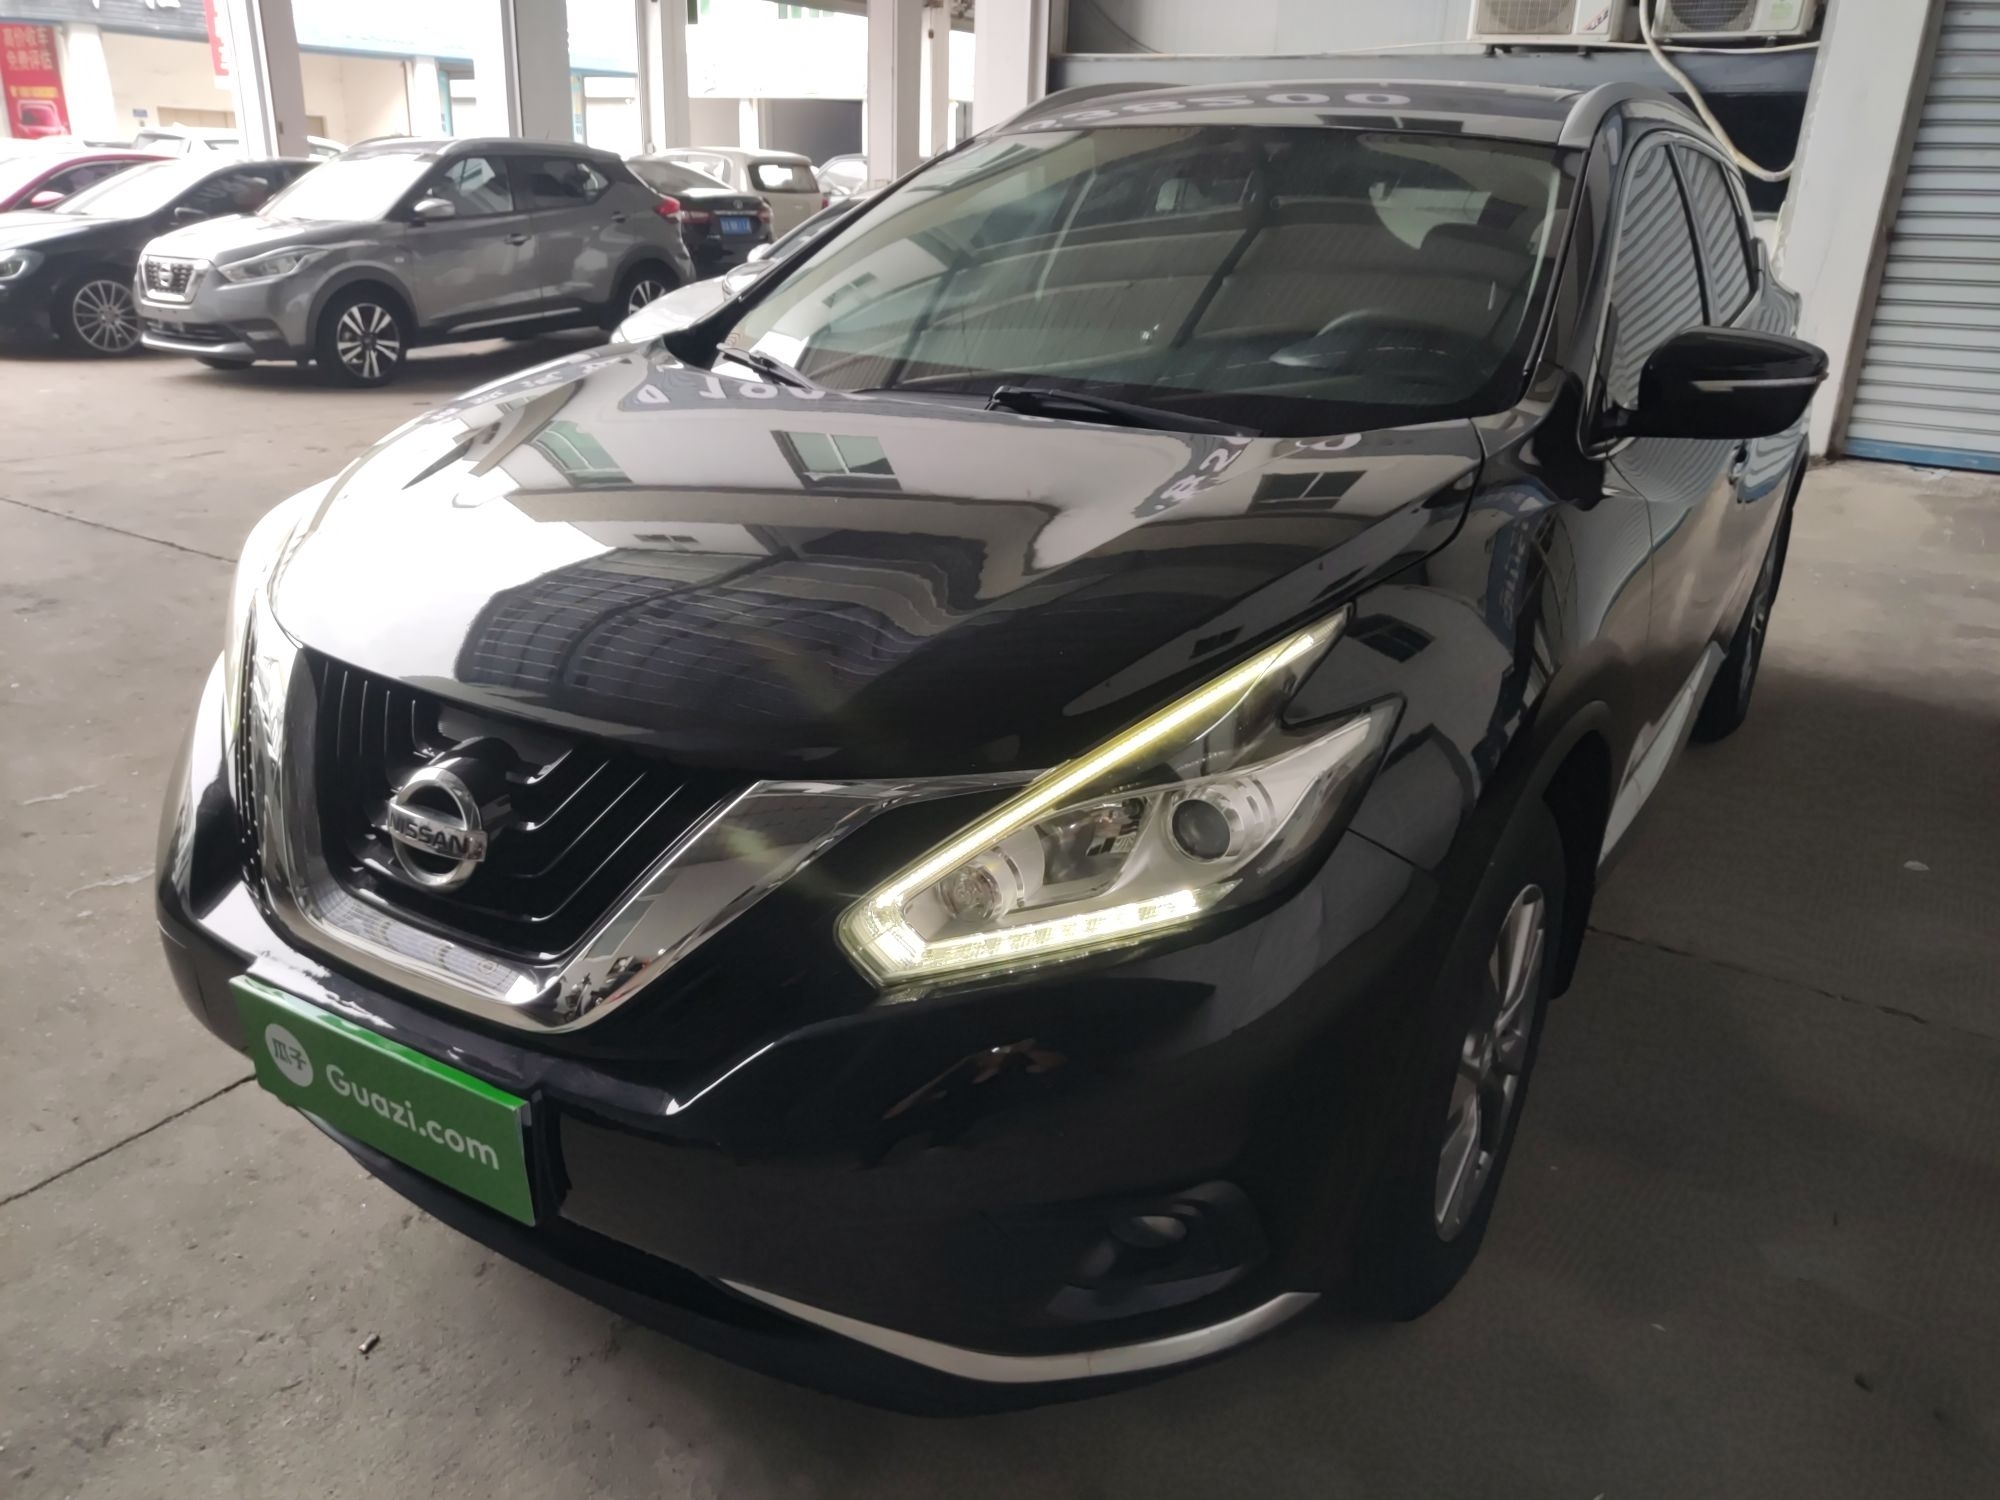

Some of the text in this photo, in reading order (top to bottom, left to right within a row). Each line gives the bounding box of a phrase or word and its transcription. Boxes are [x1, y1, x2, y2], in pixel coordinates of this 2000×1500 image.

[391, 810, 470, 857] NISSAN
[271, 1037, 307, 1071] 瓜子
[326, 1063, 499, 1170] Guazi.com
